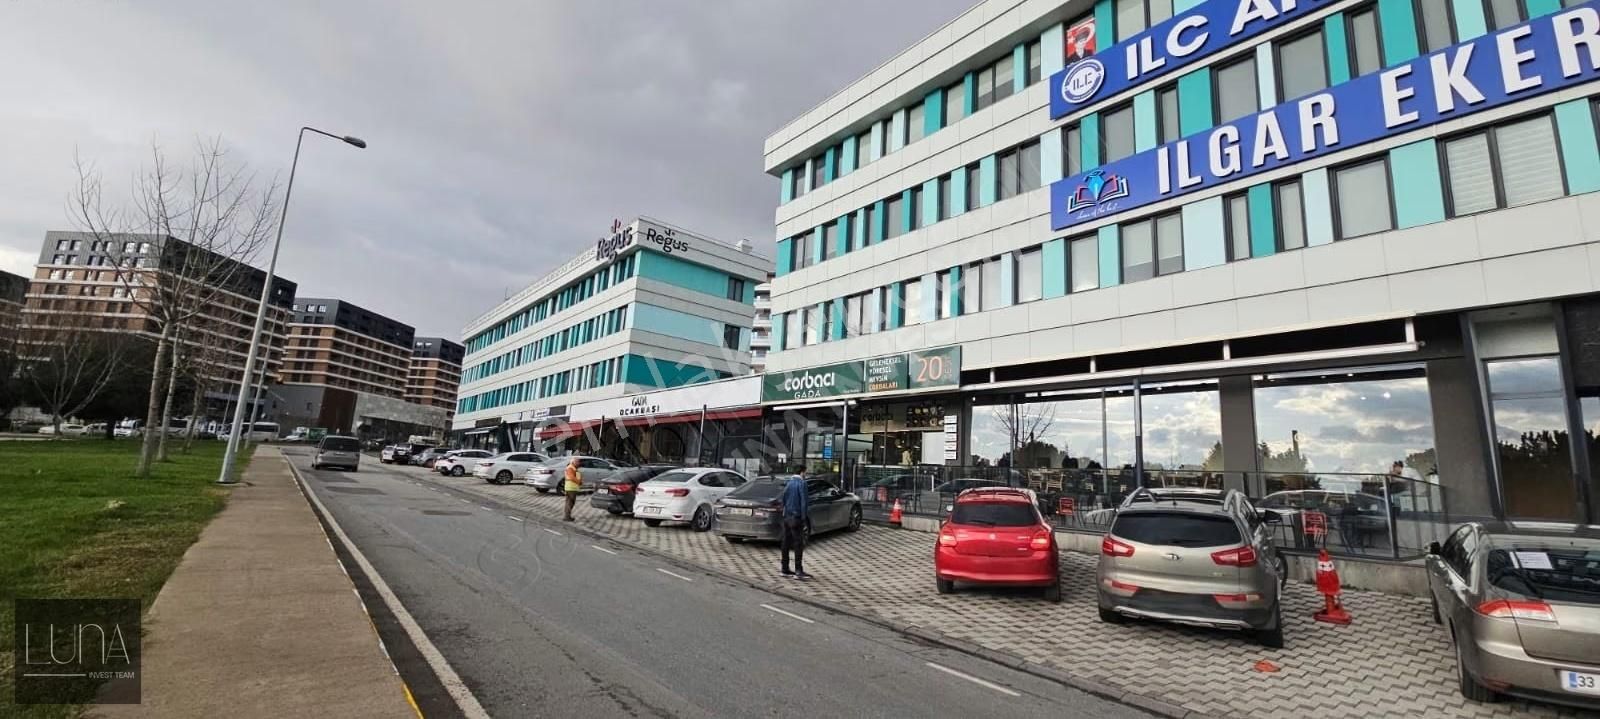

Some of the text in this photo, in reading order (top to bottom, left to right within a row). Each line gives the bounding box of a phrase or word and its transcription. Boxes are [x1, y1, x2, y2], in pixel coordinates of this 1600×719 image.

[1126, 15, 1209, 80] ILC
[1157, 91, 1338, 194] ILGAR
[596, 225, 633, 265] Regus
[646, 228, 689, 253] Regus
[916, 355, 944, 383] 20
[794, 389, 821, 400] GADA
[1577, 675, 1595, 688] 33
